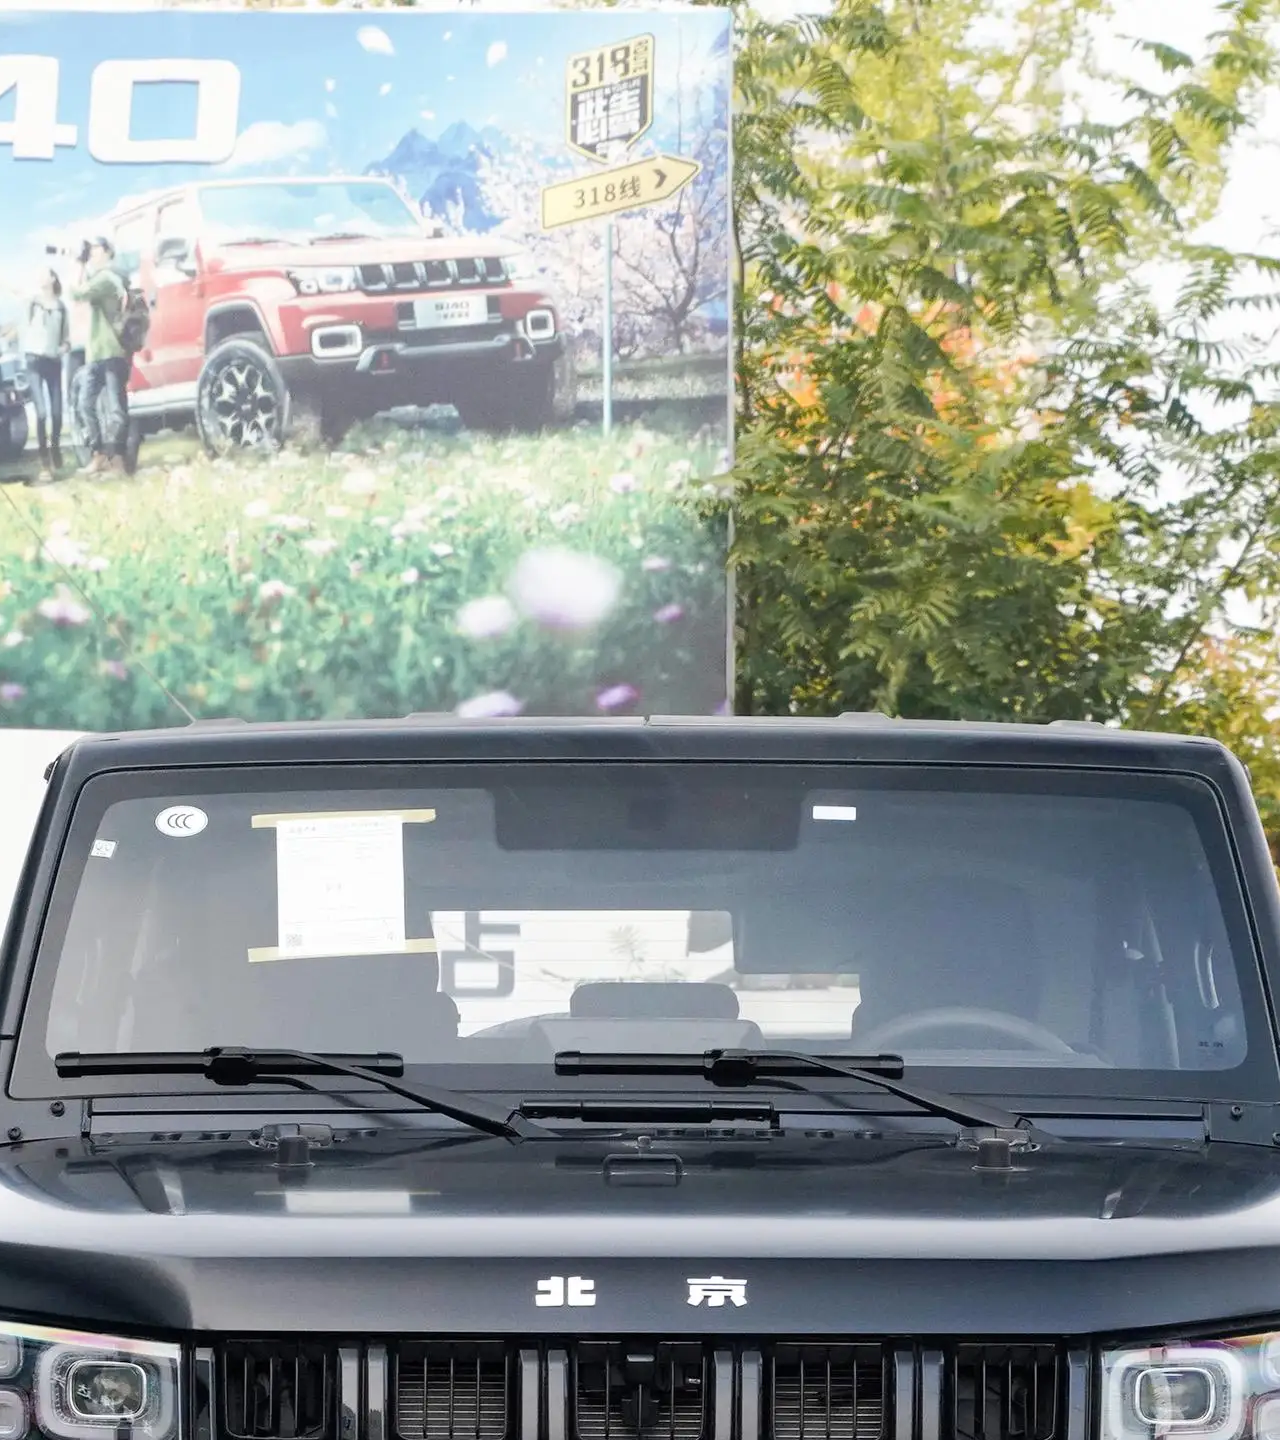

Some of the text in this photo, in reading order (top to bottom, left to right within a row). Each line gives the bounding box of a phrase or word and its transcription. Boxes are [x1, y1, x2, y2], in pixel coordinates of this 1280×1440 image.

[571, 46, 631, 89] 318
[573, 175, 641, 209] 318线
[535, 1275, 748, 1307] 北京
